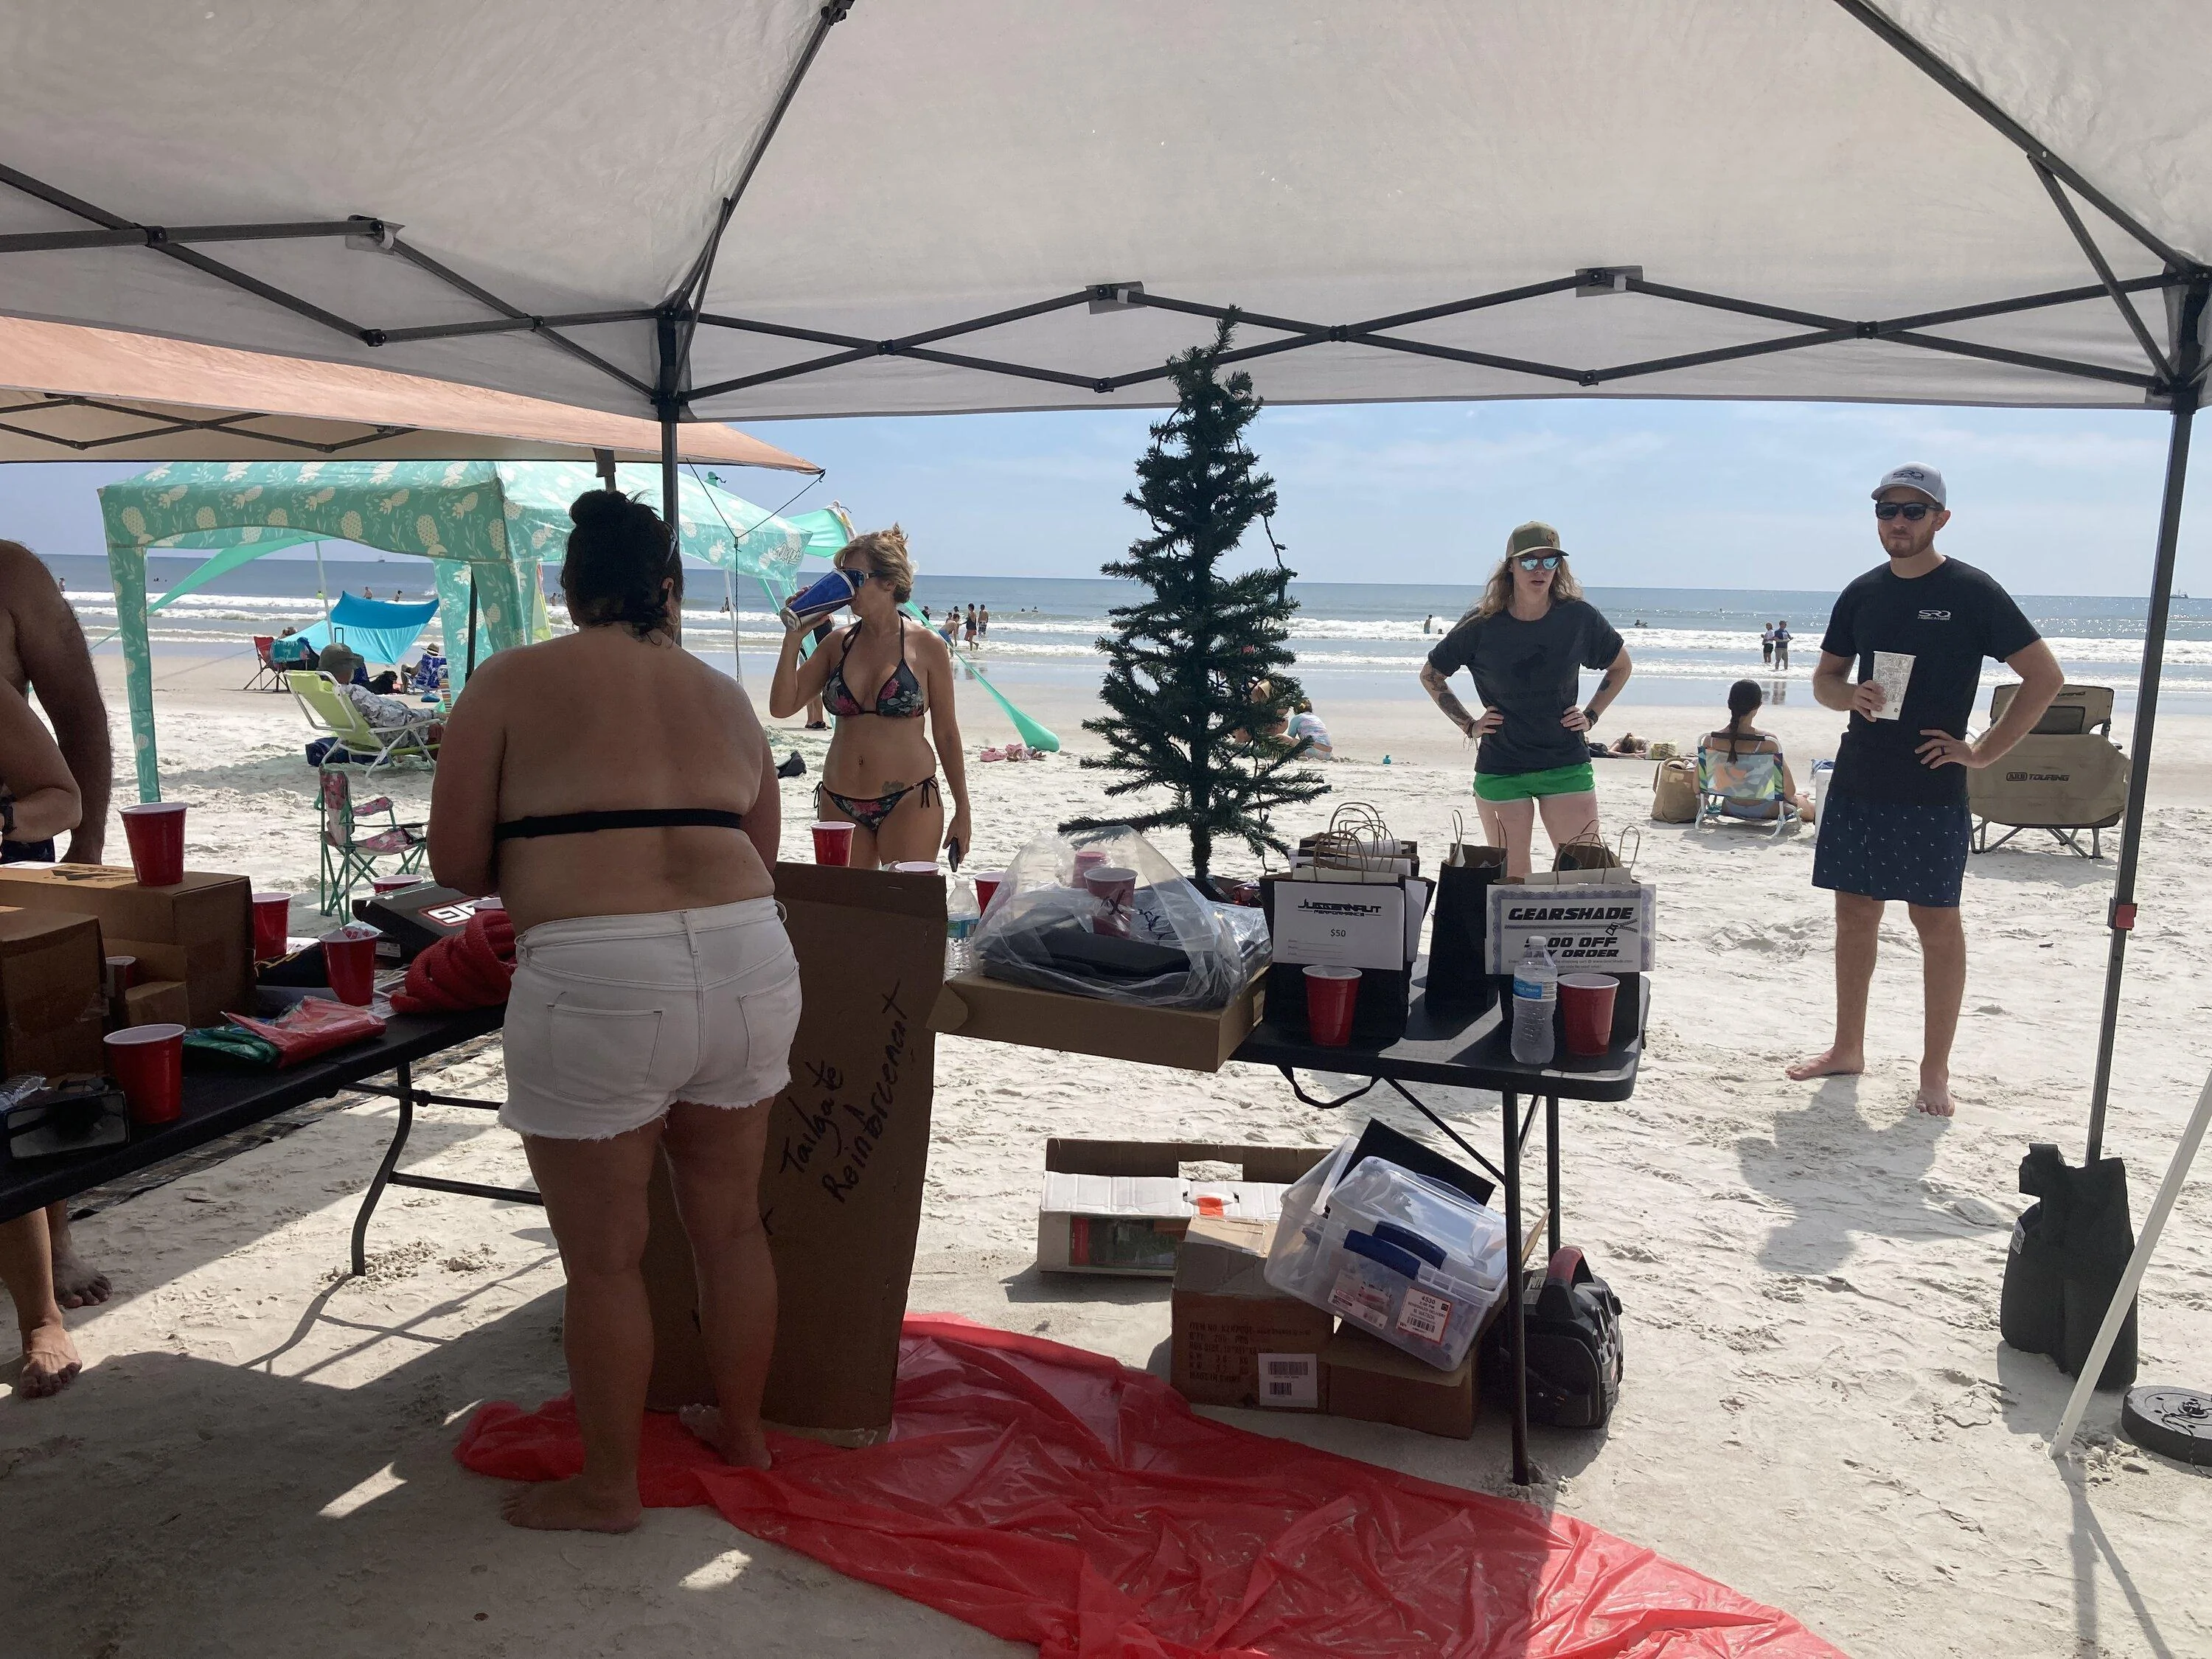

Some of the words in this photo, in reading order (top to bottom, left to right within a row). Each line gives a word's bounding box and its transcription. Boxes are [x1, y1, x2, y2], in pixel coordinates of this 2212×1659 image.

[1298, 899, 1382, 914] JUGGERNAUT
[1508, 908, 1634, 920] GEARSHADE
[1330, 928, 1346, 937] $50
[1578, 937, 1618, 947] OFF
[1562, 950, 1619, 958] ORDER
[779, 1059, 844, 1175] Tailgate
